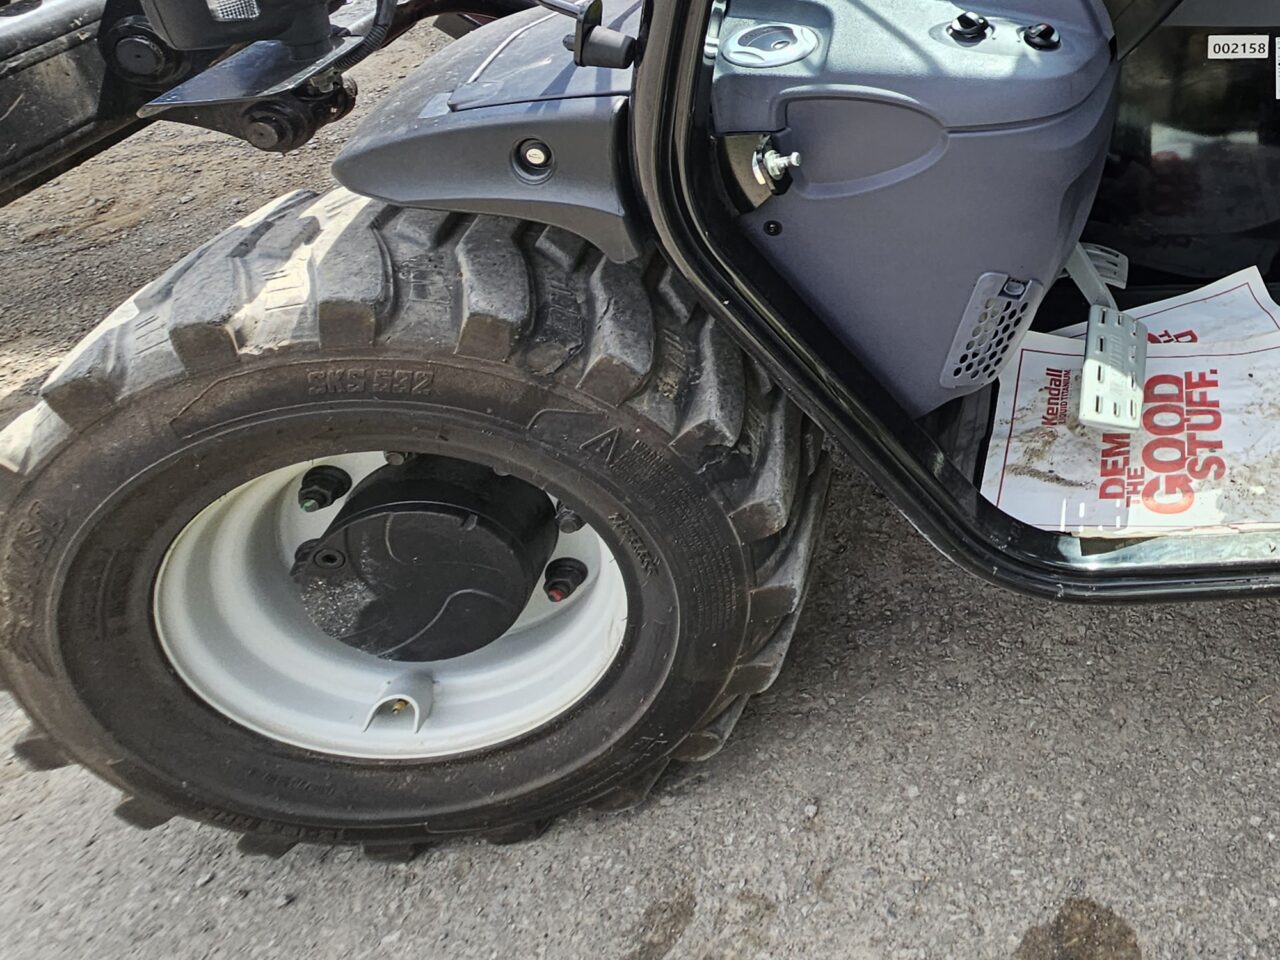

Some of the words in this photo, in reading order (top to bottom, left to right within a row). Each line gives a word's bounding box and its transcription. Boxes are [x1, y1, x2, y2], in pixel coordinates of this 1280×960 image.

[1213, 43, 1267, 54] 002158
[1041, 367, 1063, 428] Kendall
[1060, 369, 1072, 401] TITANIUM
[1058, 401, 1068, 426] LIQUID
[1184, 368, 1227, 481] STUFF.
[1099, 432, 1131, 500] DEM
[1141, 374, 1196, 514] GOOD
[1125, 466, 1145, 507] THE
